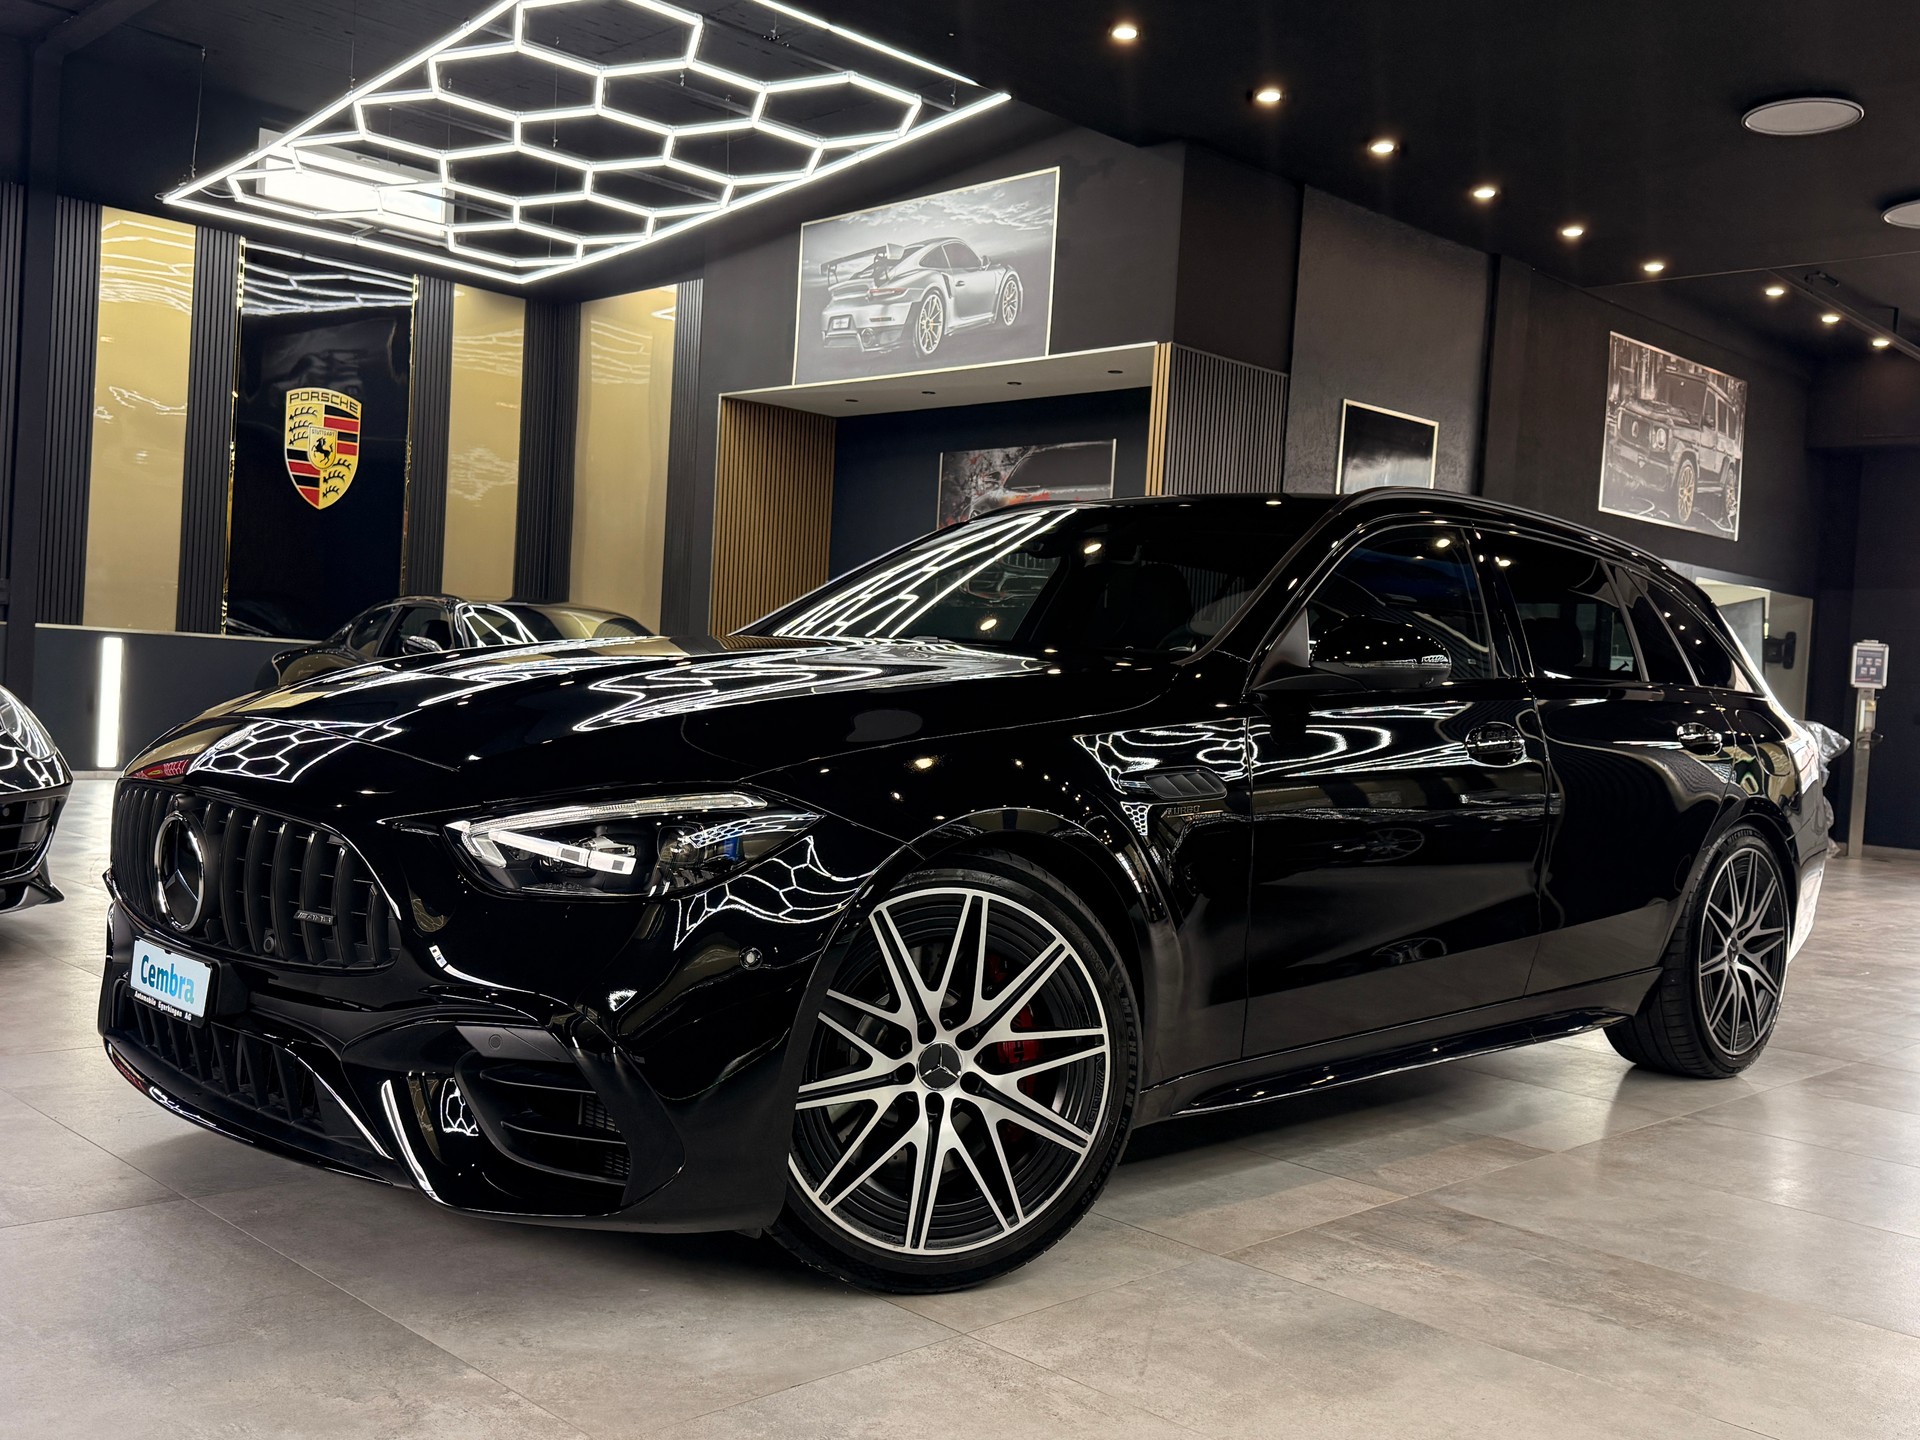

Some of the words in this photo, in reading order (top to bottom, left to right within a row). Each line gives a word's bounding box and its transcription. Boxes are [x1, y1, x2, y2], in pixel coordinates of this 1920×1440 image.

[289, 391, 358, 414] PORSCHE
[141, 955, 194, 1004] Cembra
[1120, 995, 1136, 1107] MICHELIN
